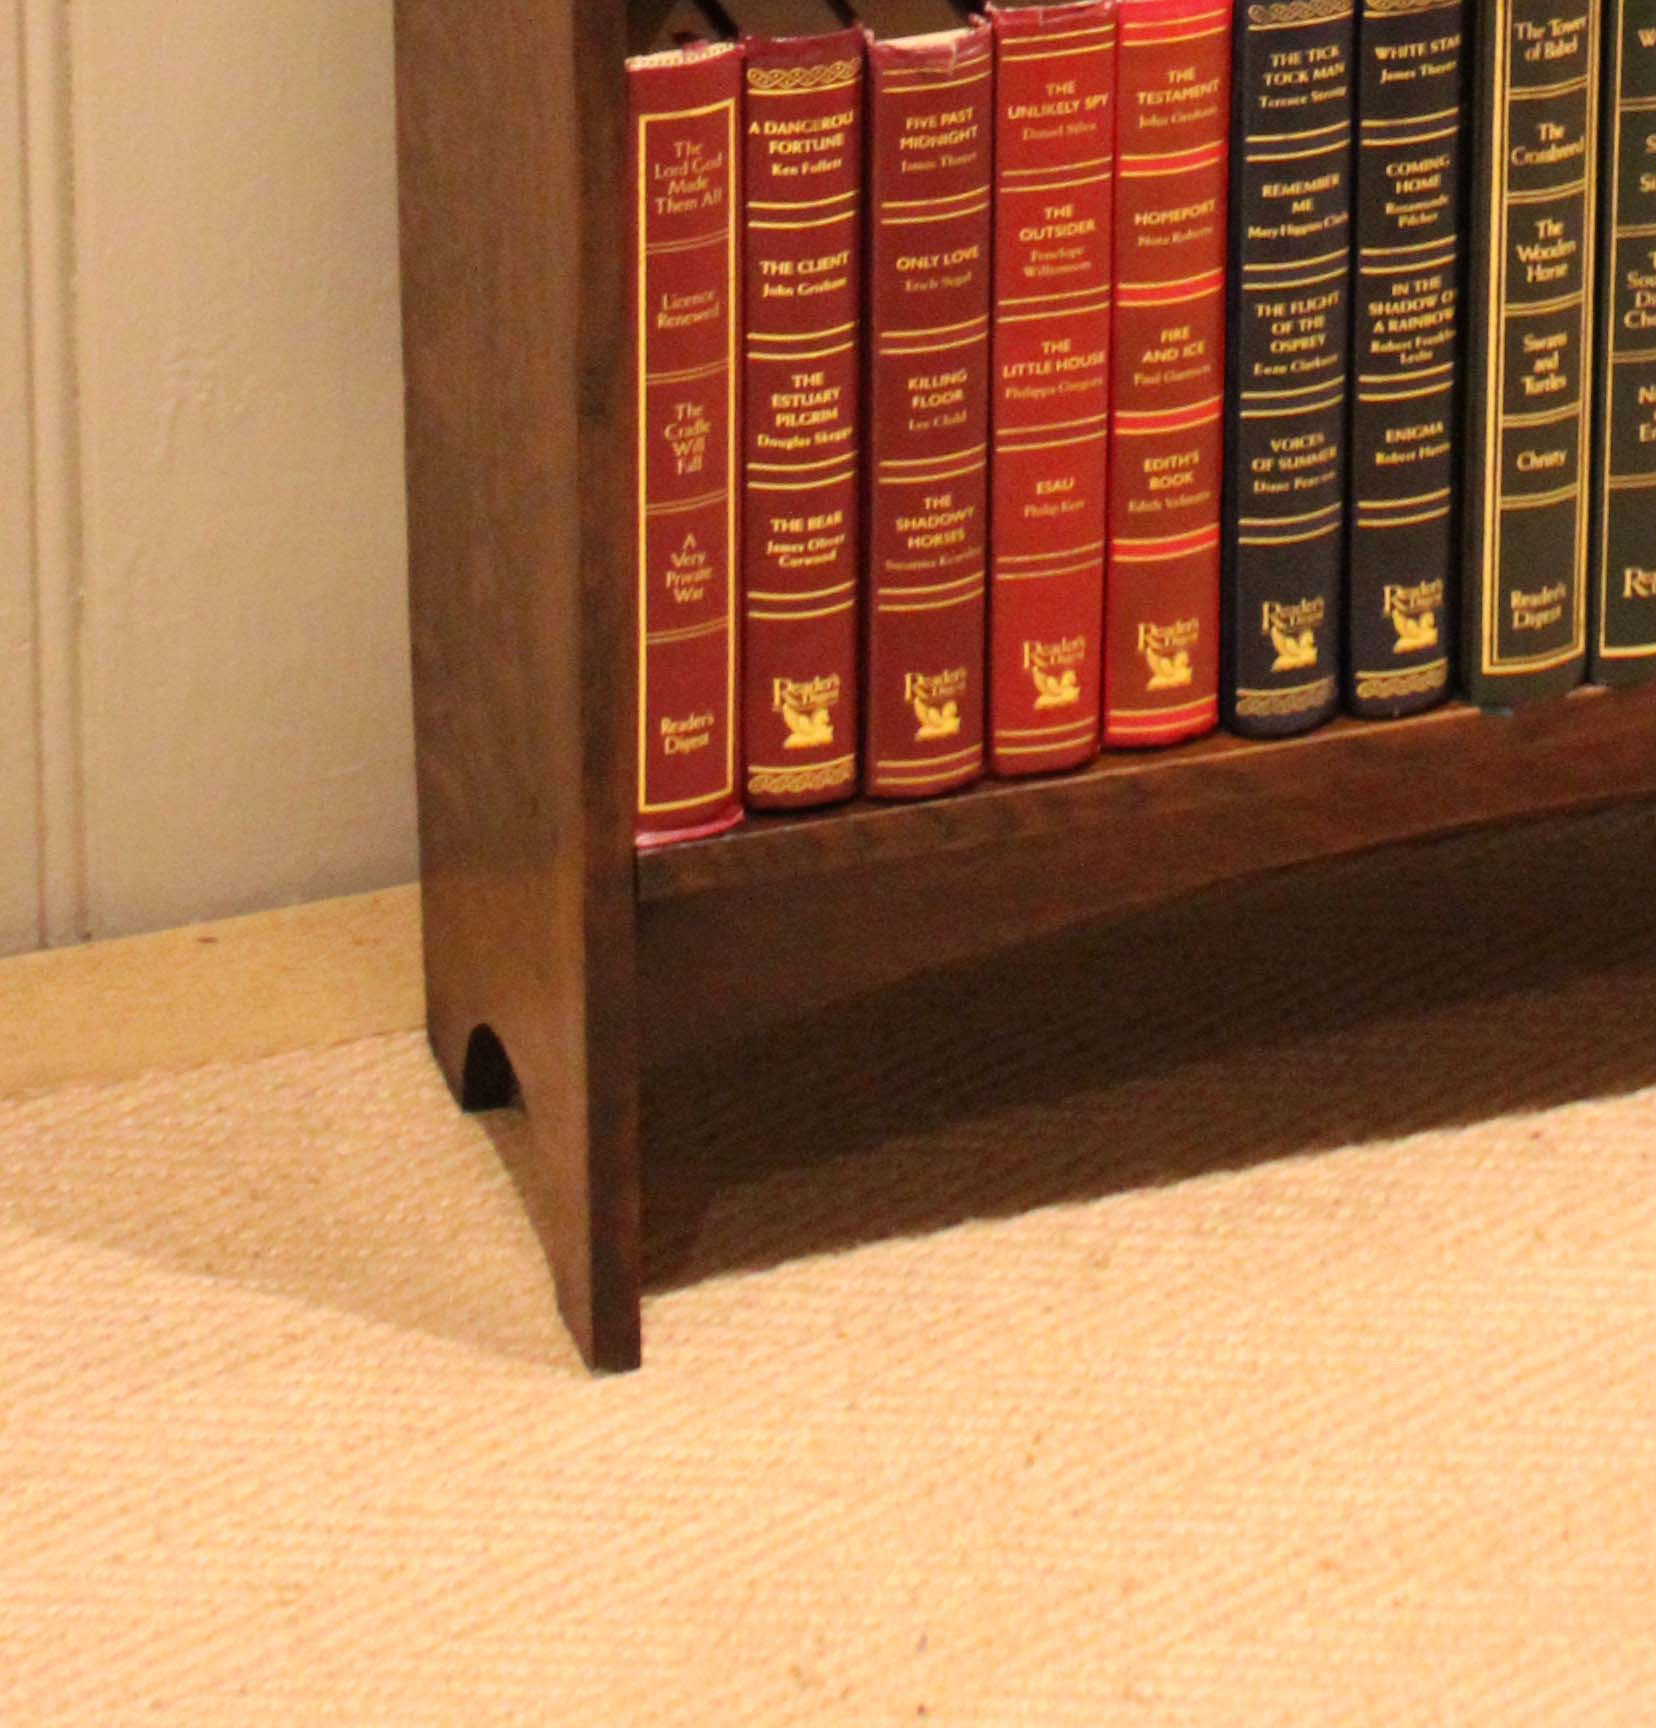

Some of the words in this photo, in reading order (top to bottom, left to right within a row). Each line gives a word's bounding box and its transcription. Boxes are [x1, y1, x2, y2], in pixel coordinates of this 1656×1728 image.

[1270, 52, 1301, 69] THE
[1307, 46, 1341, 64] TICK
[1167, 67, 1195, 84] THE
[1263, 70, 1308, 87] TOCK
[1313, 61, 1345, 81] MAN
[1045, 81, 1076, 96] THE
[1136, 79, 1221, 106] TESTAMENT
[1007, 97, 1080, 120] UNLIKELY
[1084, 92, 1110, 110] SPY
[906, 113, 937, 130] FIVE
[940, 107, 974, 125] PAST
[900, 124, 978, 151] MIDNIGHT
[1537, 122, 1566, 141] The
[674, 141, 703, 158] The
[769, 133, 844, 155] FORTUNE
[655, 162, 688, 180] Lord
[692, 152, 723, 175] God
[1395, 173, 1442, 195] HOME
[655, 196, 699, 215] Them
[701, 189, 723, 207] All
[1044, 204, 1074, 220] THE
[1019, 219, 1096, 242] OUTSIDER
[1536, 218, 1564, 239] The
[760, 259, 793, 276] THE
[798, 250, 849, 273] CLIENT
[896, 255, 939, 272] ONLY
[943, 245, 979, 266] LOVE
[1391, 281, 1410, 297] IN
[1413, 275, 1442, 294] THE
[656, 303, 720, 329] Renewed
[1256, 301, 1288, 319] THE
[1290, 291, 1340, 314] FLIGHT
[1041, 338, 1072, 355] THE
[1160, 326, 1190, 344] FIRE
[1002, 357, 1053, 379] LITTLE
[1056, 350, 1106, 373] HOUSE
[792, 372, 824, 389] THE
[907, 368, 968, 391] KILLING
[771, 387, 840, 410] ESTUARY
[675, 402, 704, 421] The
[775, 407, 838, 428] PILGRIM
[922, 494, 952, 510] THE
[770, 515, 804, 534] THE
[807, 510, 843, 531] BEAR
[896, 505, 975, 532] SHADOWY
[683, 533, 696, 548] A
[671, 550, 705, 571] Very
[664, 732, 710, 756] Digest
